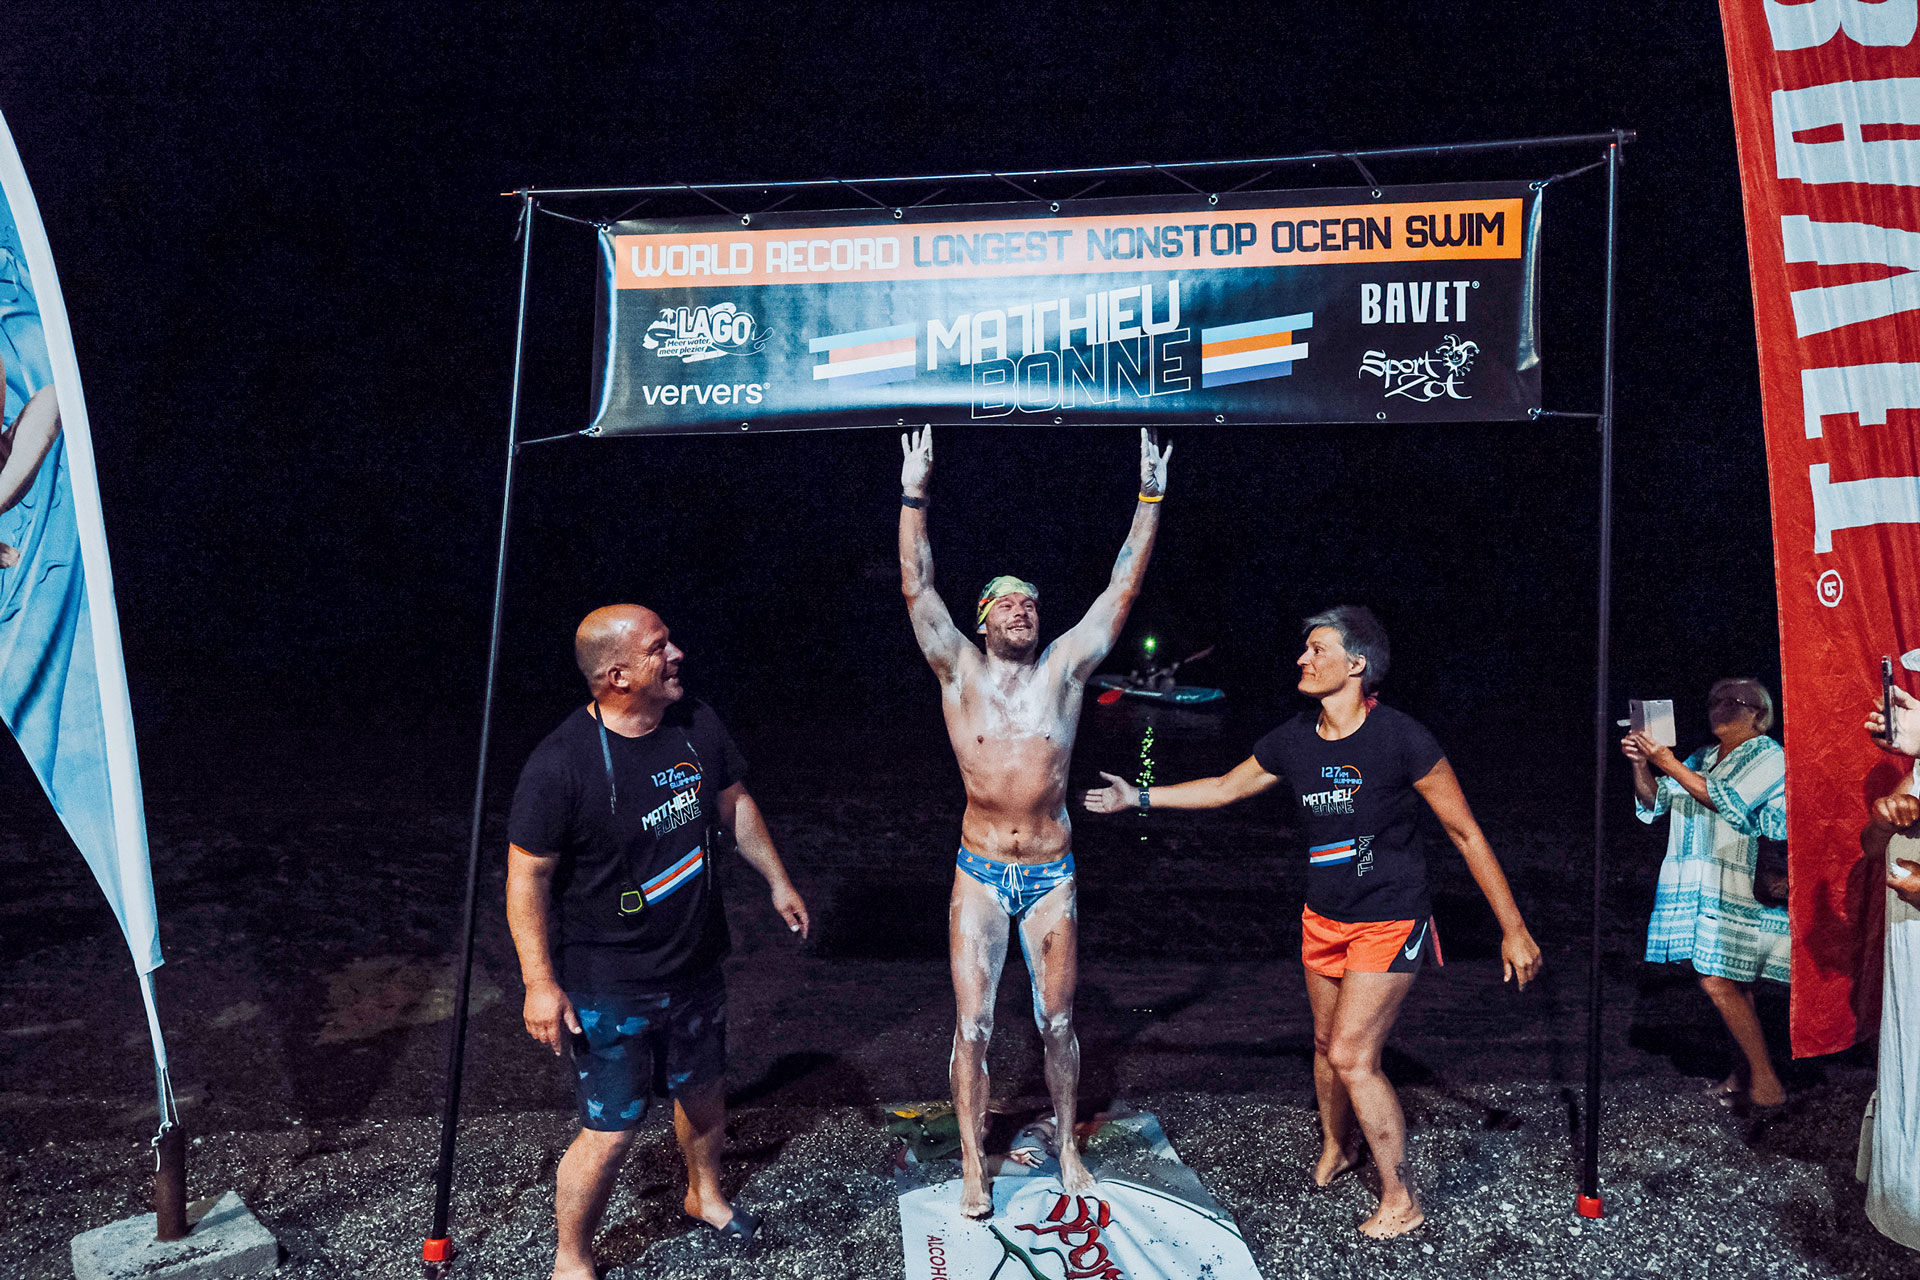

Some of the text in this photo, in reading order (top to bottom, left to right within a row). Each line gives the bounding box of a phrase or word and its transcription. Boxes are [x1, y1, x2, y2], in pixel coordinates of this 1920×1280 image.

[631, 211, 1505, 278] WORLD RECORD LONGEST NONSTOP OCEAN SWIM
[666, 339, 686, 347] Meer
[677, 307, 752, 346] LAGO
[680, 345, 706, 354] plezier
[1359, 349, 1442, 389] Sport
[971, 327, 1191, 419] BONNE
[1384, 373, 1473, 403] Zot
